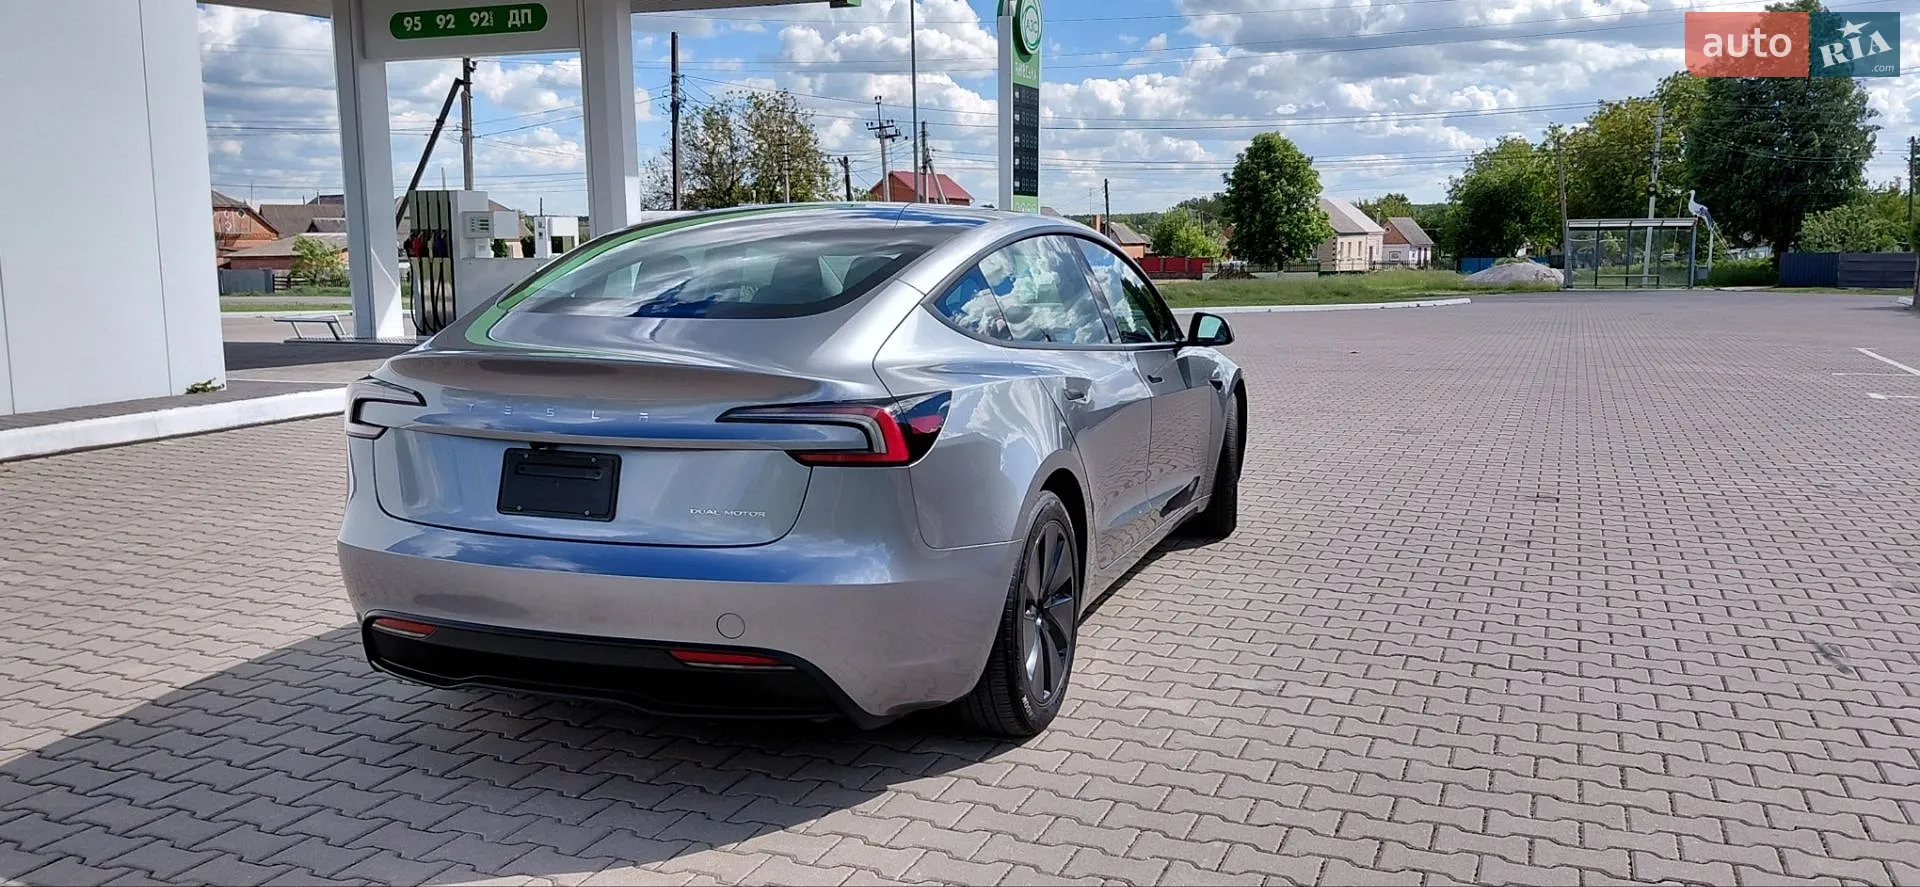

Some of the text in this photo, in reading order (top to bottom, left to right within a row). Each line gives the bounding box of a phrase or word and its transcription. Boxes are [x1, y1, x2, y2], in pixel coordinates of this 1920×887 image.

[403, 16, 422, 31] 95
[435, 14, 456, 29] 92
[470, 11, 490, 28] 92
[507, 8, 532, 28] ДП
[466, 403, 649, 423] TESLA
[689, 508, 766, 518] DUAL MOTOR
